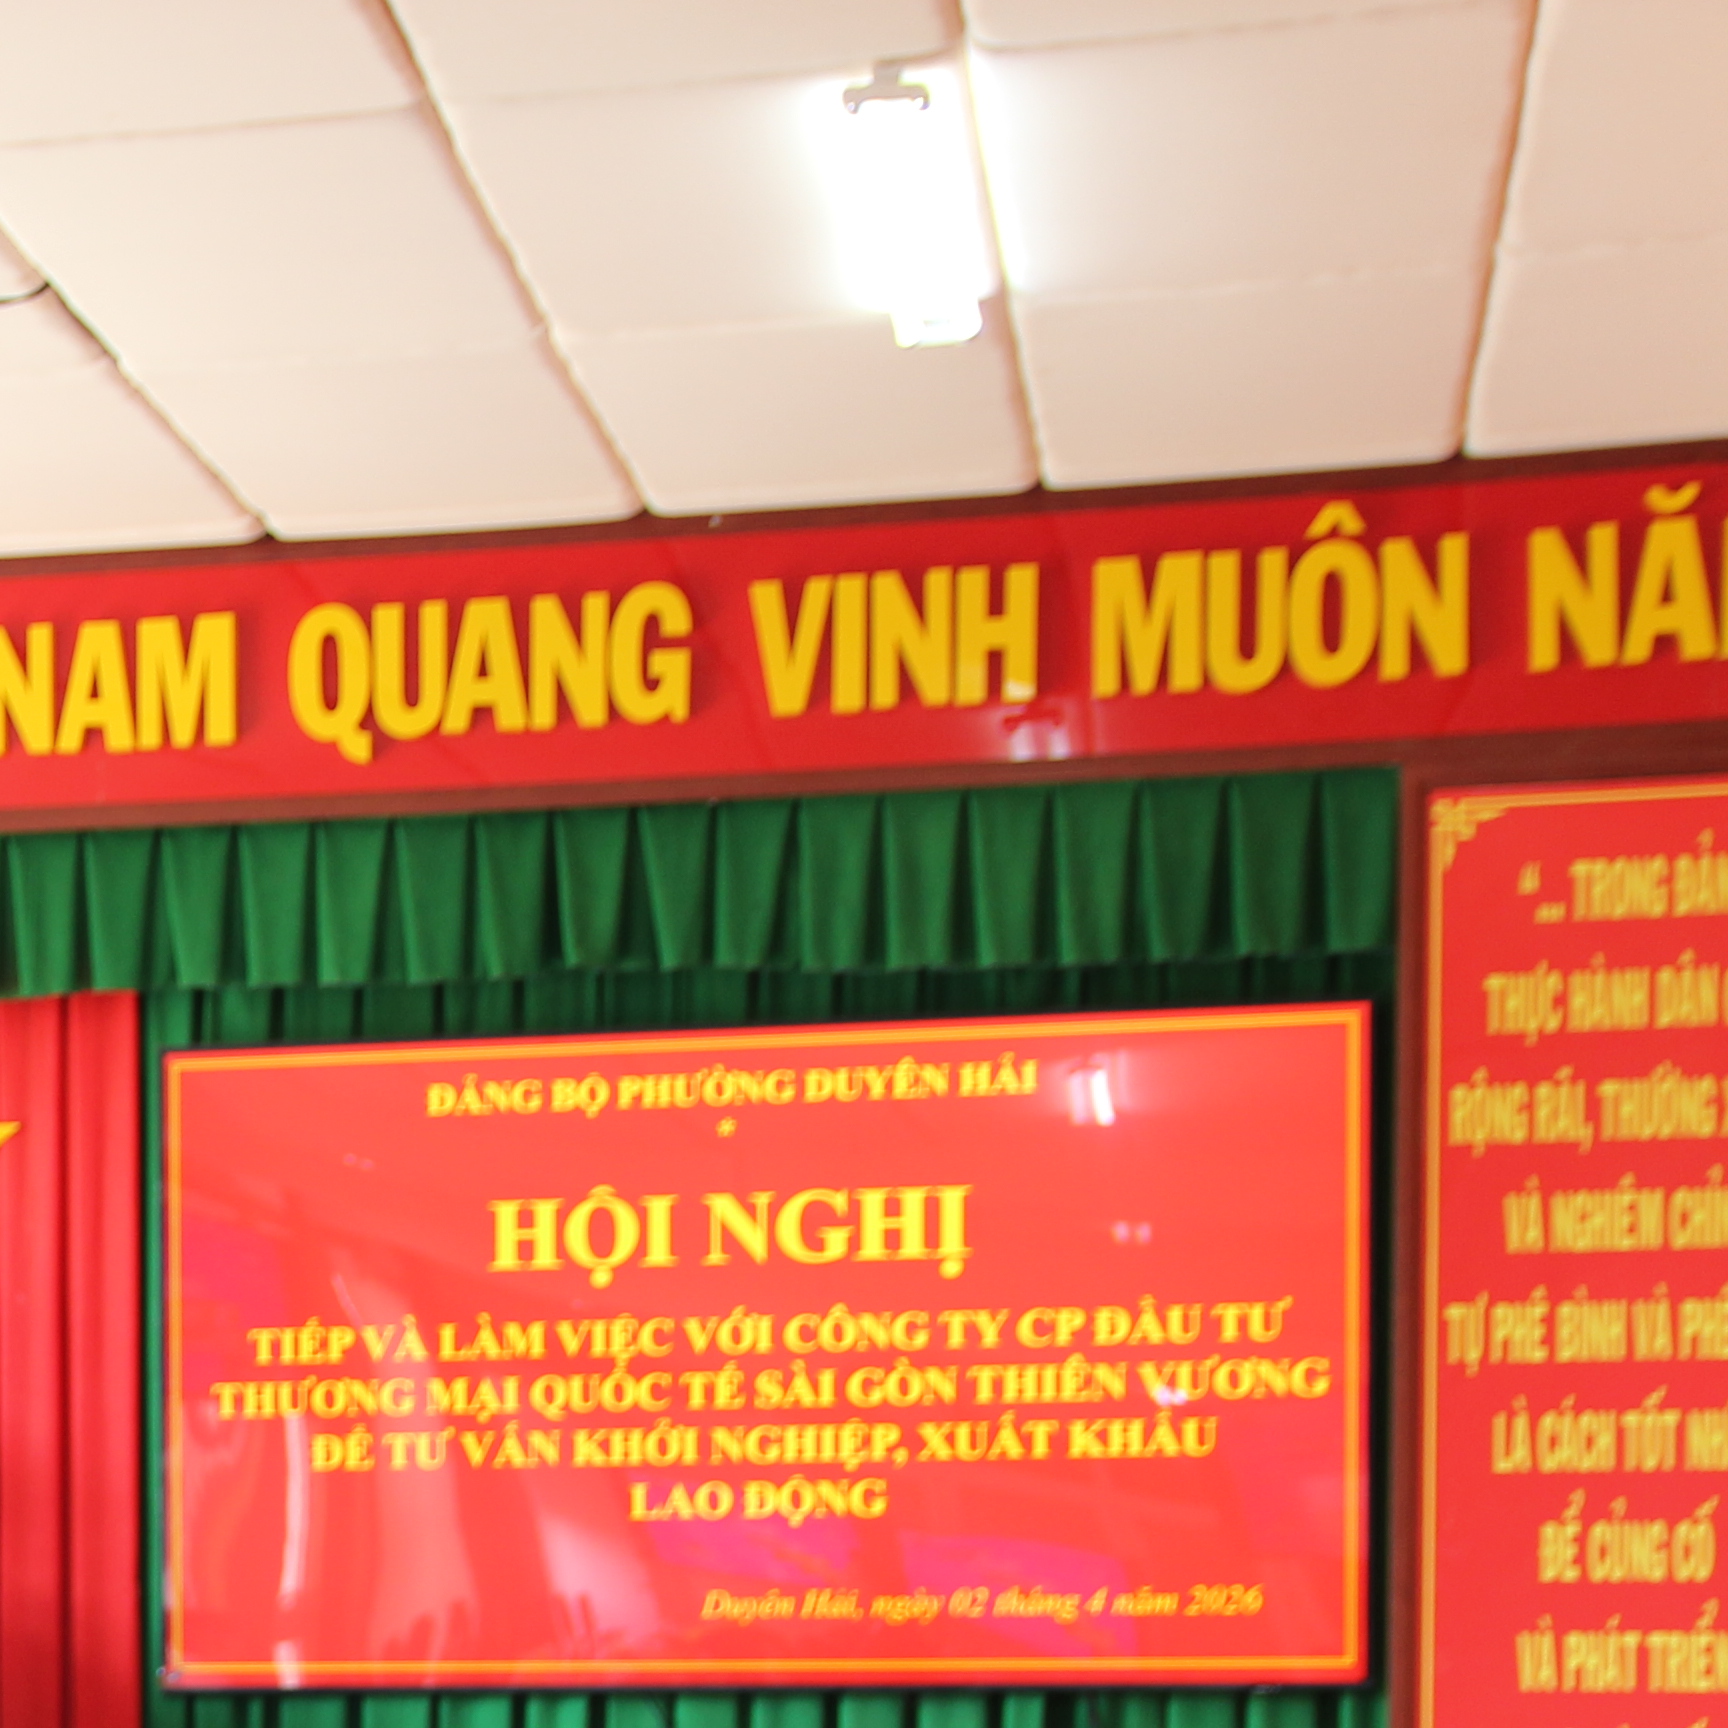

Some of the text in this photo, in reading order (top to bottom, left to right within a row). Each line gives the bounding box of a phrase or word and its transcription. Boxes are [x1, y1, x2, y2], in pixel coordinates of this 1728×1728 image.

[286, 581, 693, 766] QUANG
[748, 562, 1039, 718] VINH
[1091, 500, 1470, 699] MUÔN
[1527, 482, 1728, 673] NĂ
[1568, 853, 1669, 922] TRONG
[426, 1051, 1039, 1119] ĐẢNG BỘ PHƯỜNG DUYÊN HẢI
[487, 1184, 973, 1289] HỘI NGHỊ
[247, 1294, 1294, 1366] TIẾP VÀ LÀM VIỆC VỚI CÔNG TY CP ĐẦU TƯ
[210, 1353, 1332, 1424] THƯƠNG MẠI QUỐC TẾ SÀI GÒN THIÊN VƯƠNG
[309, 1407, 1219, 1473] ĐỂ TƯ VẤN KHỞI NGHIỆP, XUẤT KHẨU
[1490, 1393, 1534, 1475] LÀ
[1536, 1392, 1618, 1475] CÁCH
[628, 1474, 889, 1528] LAO ĐỘNG
[1537, 1487, 1587, 1584] ĐỂ
[1671, 1494, 1720, 1584] CỐ
[700, 1588, 797, 1627] Duyên
[947, 1585, 990, 1618] 02
[1182, 1583, 1265, 1617] 2026
[1515, 1613, 1558, 1693] VÀ
[1561, 1612, 1643, 1693] PHÁT
